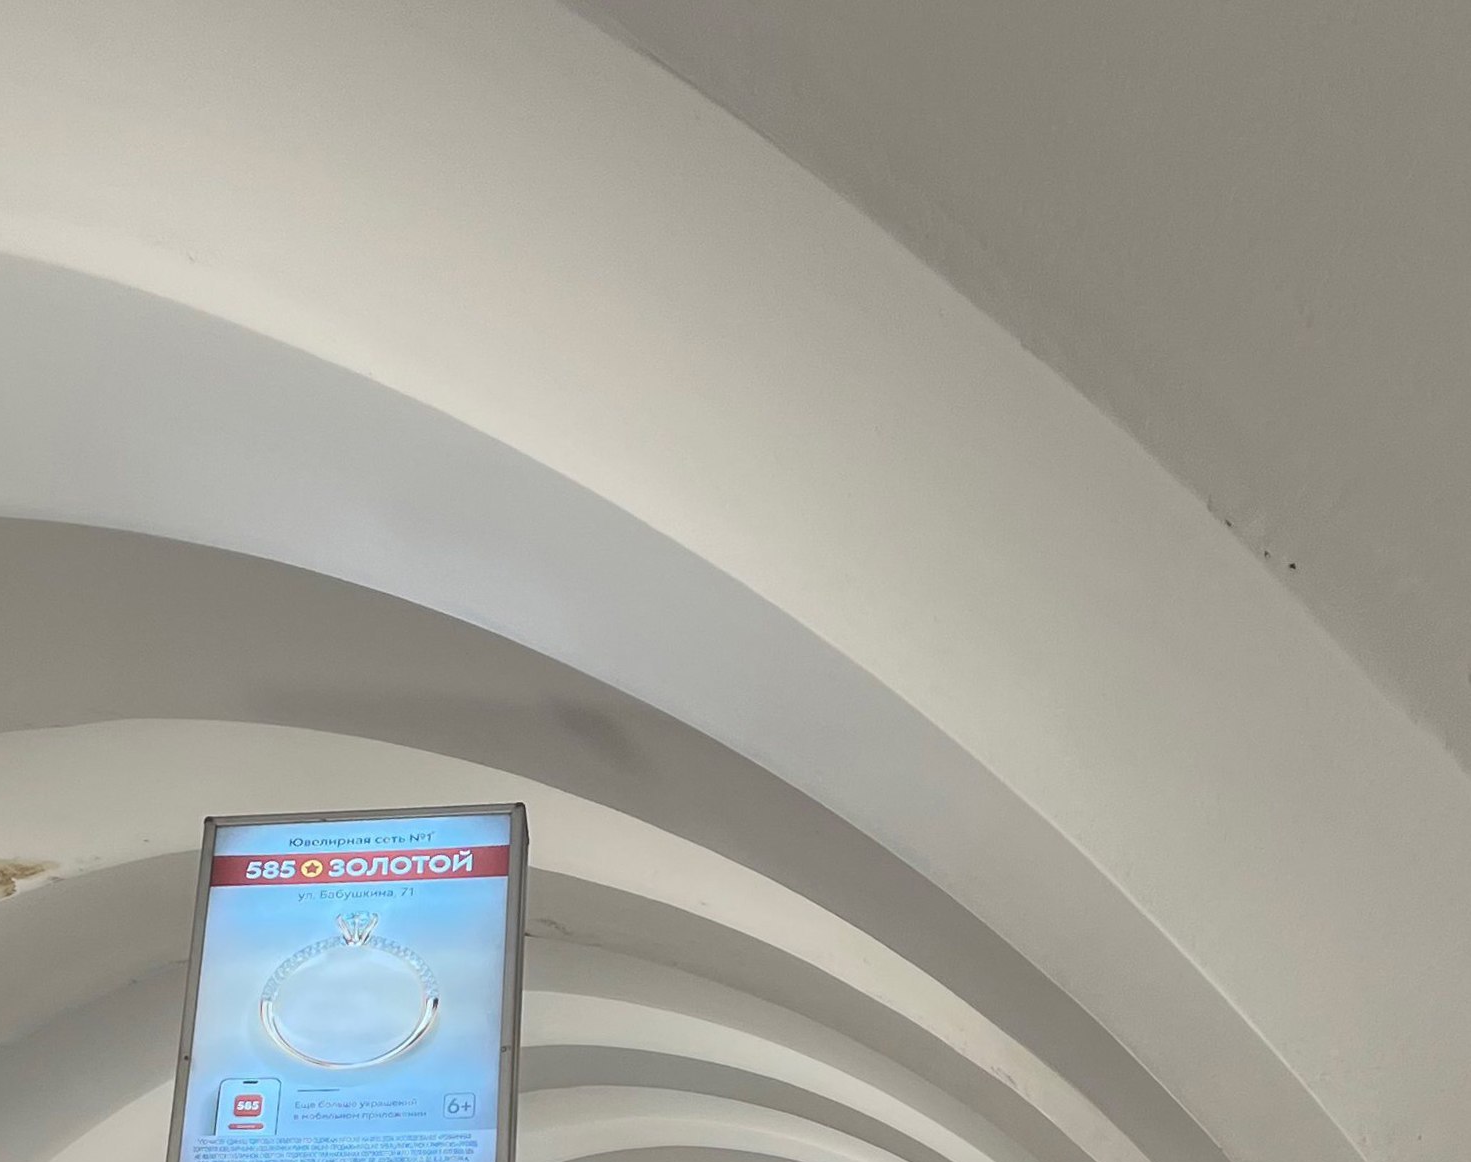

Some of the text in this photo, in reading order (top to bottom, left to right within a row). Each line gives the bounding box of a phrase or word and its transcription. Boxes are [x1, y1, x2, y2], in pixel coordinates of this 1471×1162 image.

[288, 835, 371, 848] Ювелирная
[375, 834, 406, 845] сеть
[245, 849, 473, 880] 585 ЗОЛОТОЙ
[298, 892, 315, 902] ул.
[400, 887, 415, 898] 71
[236, 1100, 260, 1111] 585
[447, 1098, 471, 1114] 6+
